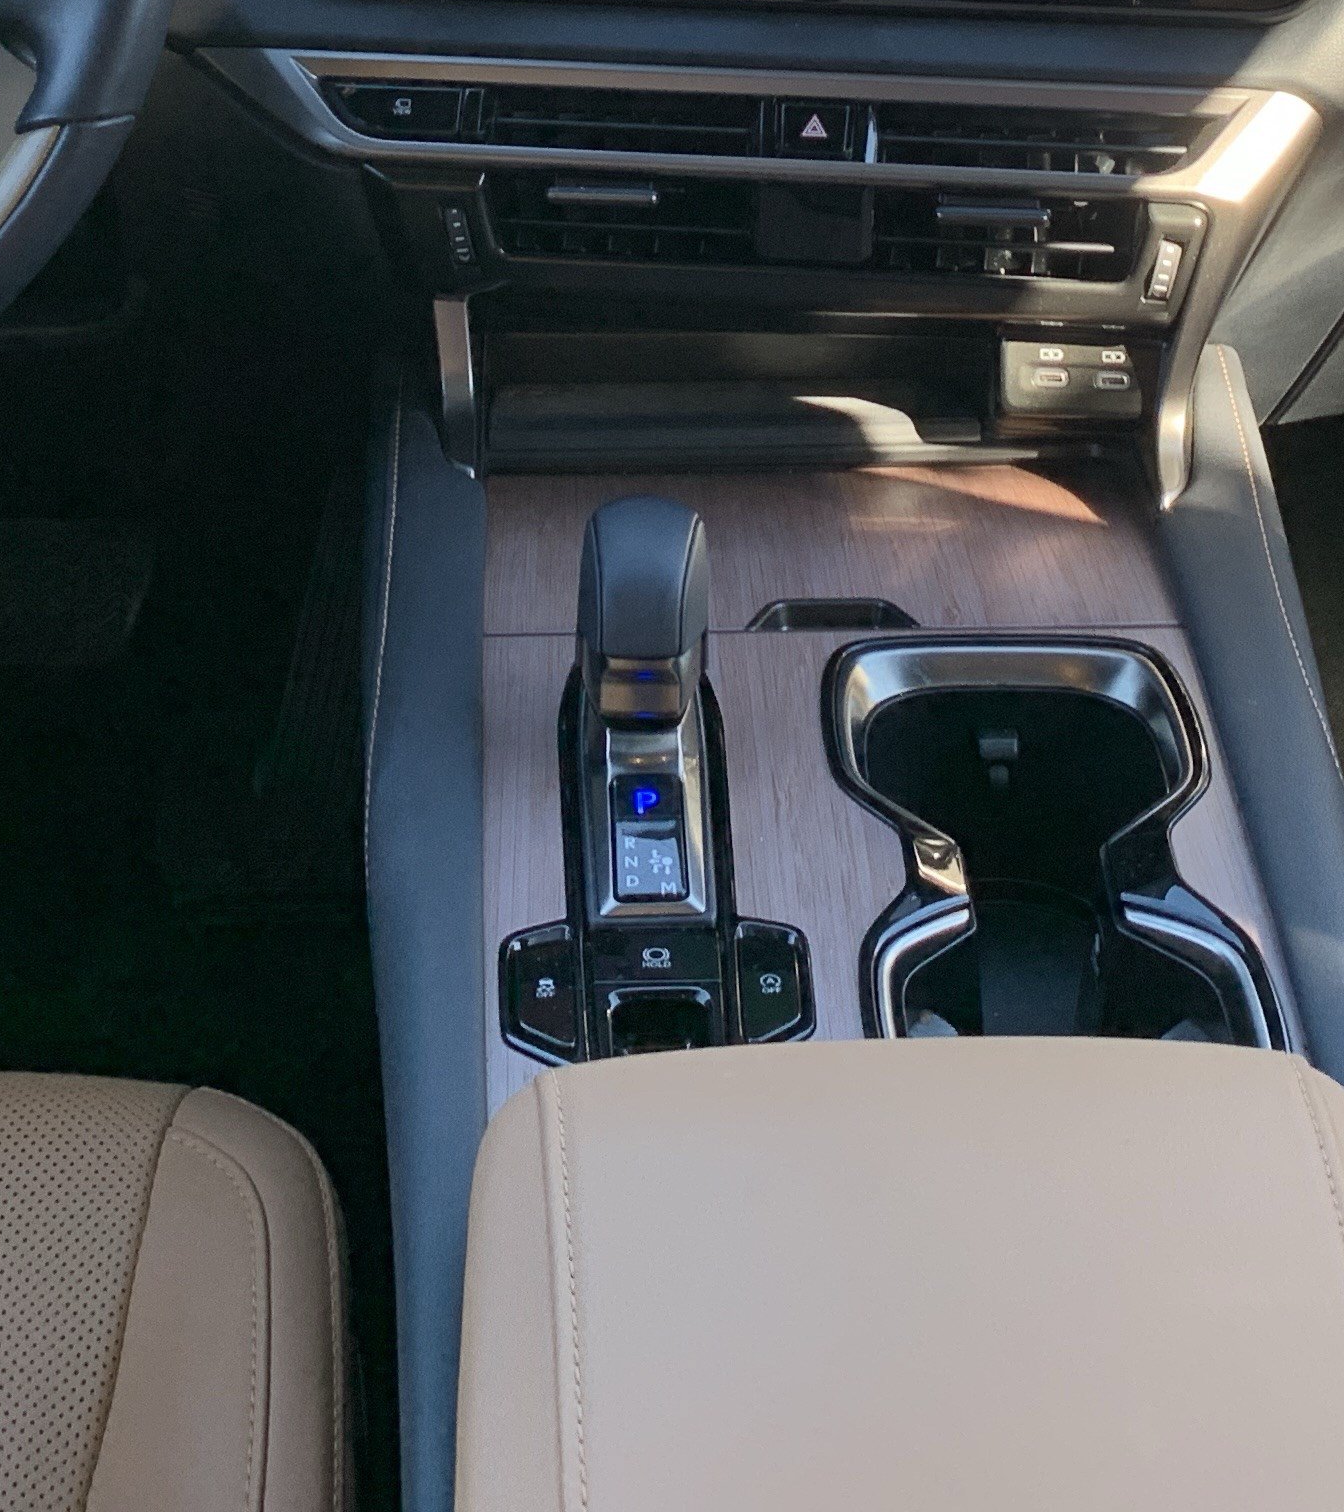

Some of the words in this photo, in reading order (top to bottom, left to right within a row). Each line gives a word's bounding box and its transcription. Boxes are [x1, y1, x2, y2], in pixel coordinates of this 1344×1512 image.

[636, 790, 657, 815] P
[624, 836, 636, 849] R
[624, 855, 638, 868] N
[626, 874, 639, 888] D
[660, 881, 677, 895] M
